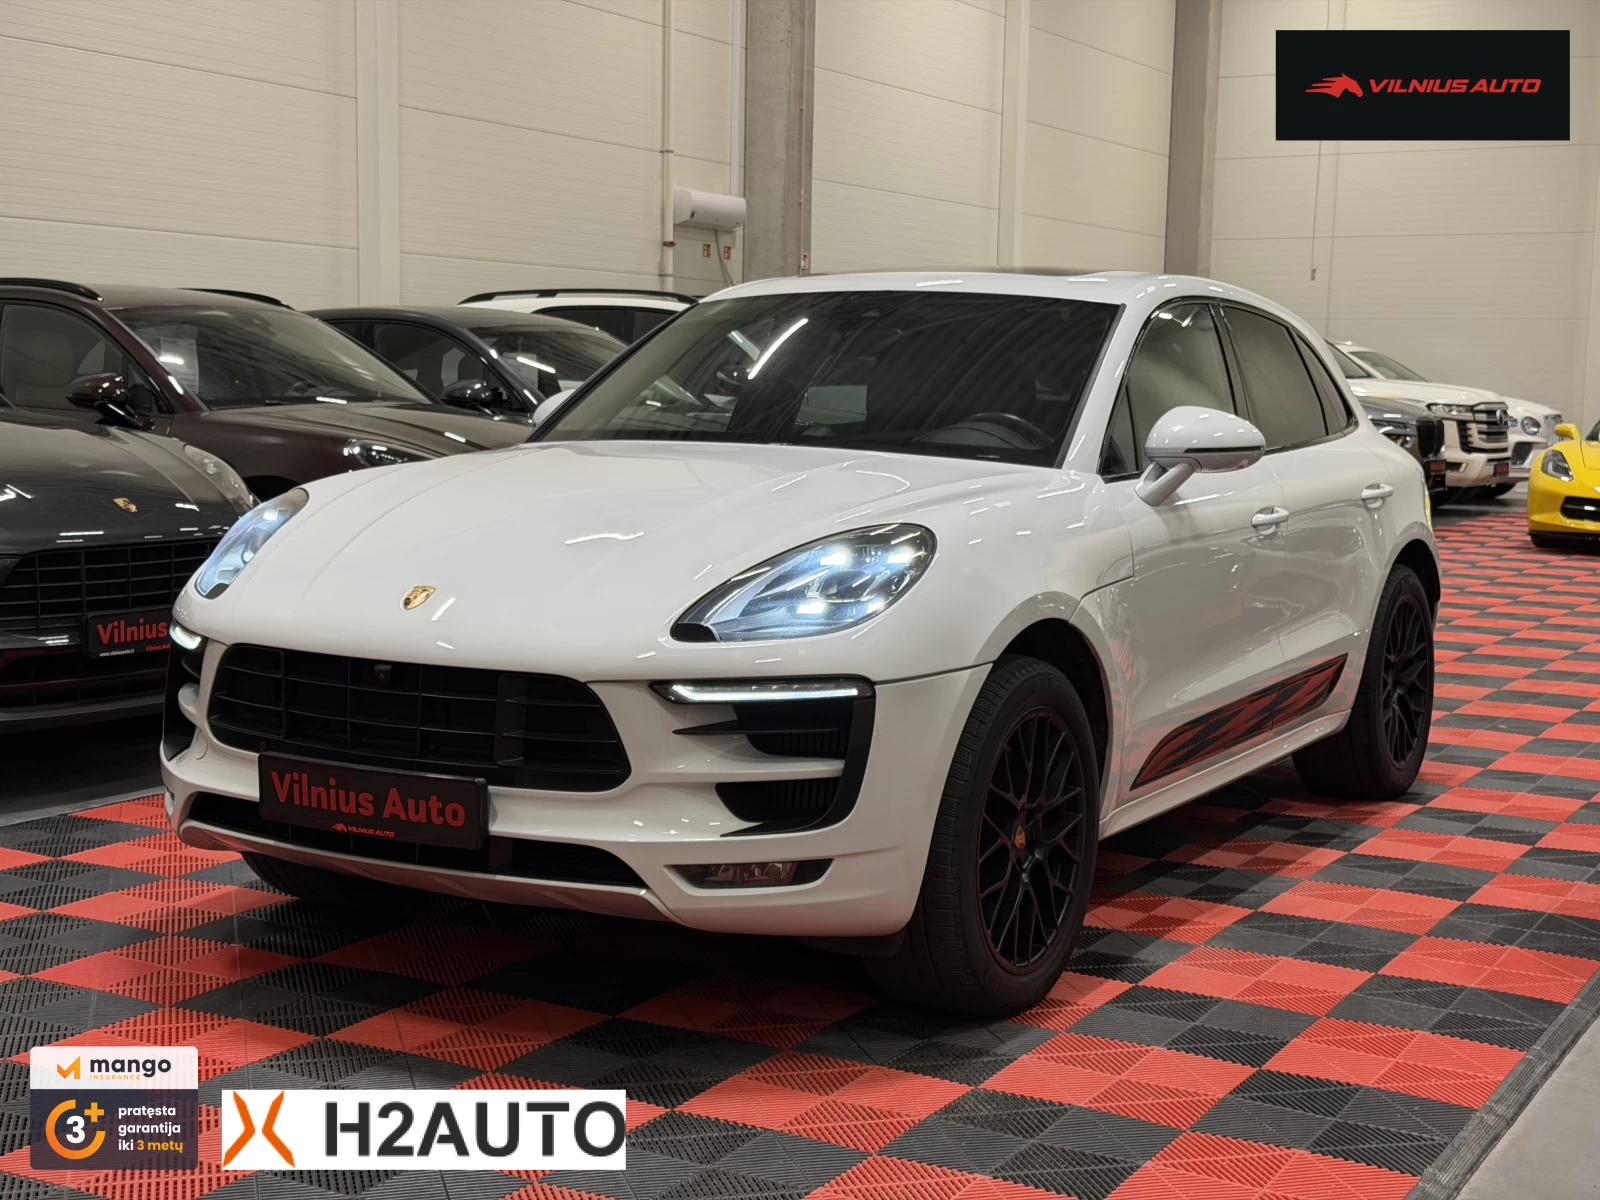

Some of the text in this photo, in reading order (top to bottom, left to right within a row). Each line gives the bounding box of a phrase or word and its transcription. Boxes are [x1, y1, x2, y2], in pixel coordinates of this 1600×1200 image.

[97, 618, 168, 645] Vilnius
[271, 771, 466, 827] Vilnius Auto
[347, 826, 374, 834] VILNIUS
